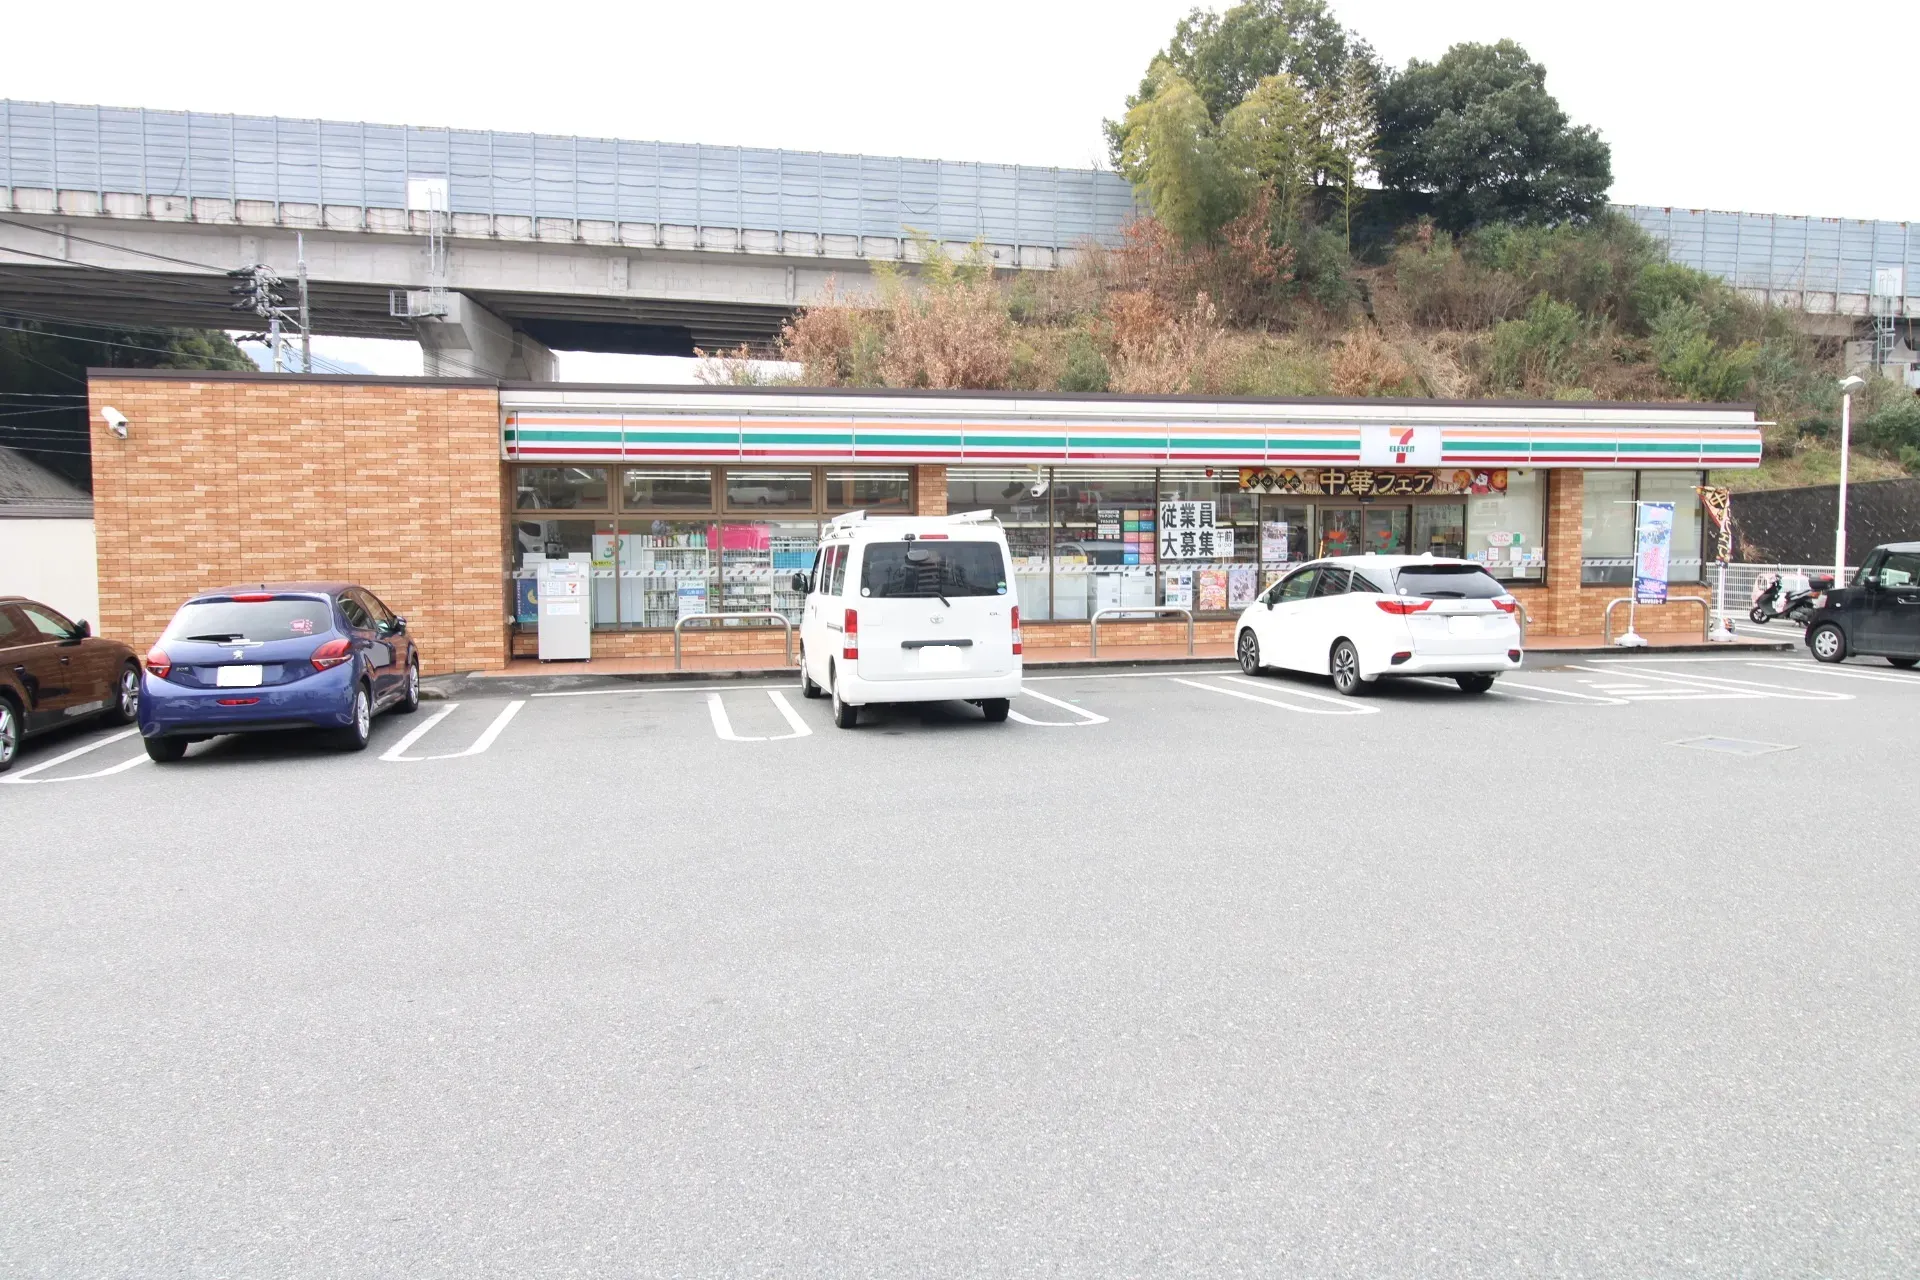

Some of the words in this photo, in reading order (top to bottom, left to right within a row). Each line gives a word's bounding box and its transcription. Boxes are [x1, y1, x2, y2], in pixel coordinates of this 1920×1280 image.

[1389, 427, 1414, 464] 7
[1320, 467, 1434, 495] 中華フェア
[1161, 502, 1214, 529] 従業員
[1161, 531, 1215, 558] 大募集
[1216, 530, 1233, 543] 午前
